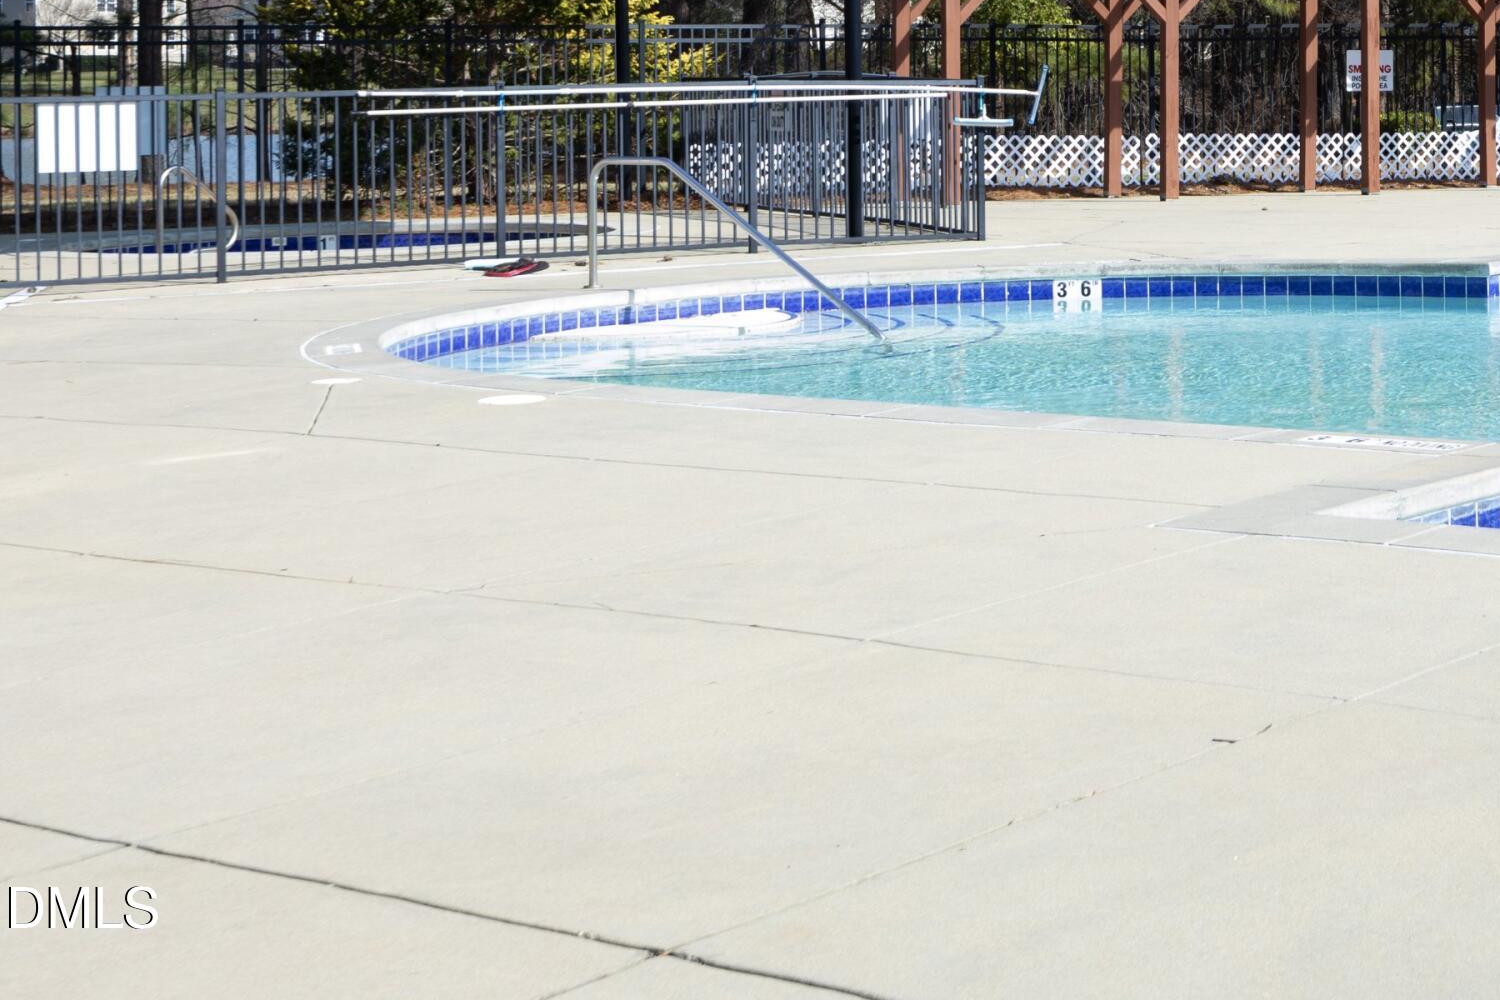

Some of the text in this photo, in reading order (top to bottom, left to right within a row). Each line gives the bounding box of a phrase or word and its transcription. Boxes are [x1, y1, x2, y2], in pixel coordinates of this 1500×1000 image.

[1348, 64, 1392, 74] SMNG
[1057, 281, 1068, 298] 3
[1080, 280, 1092, 297] 6
